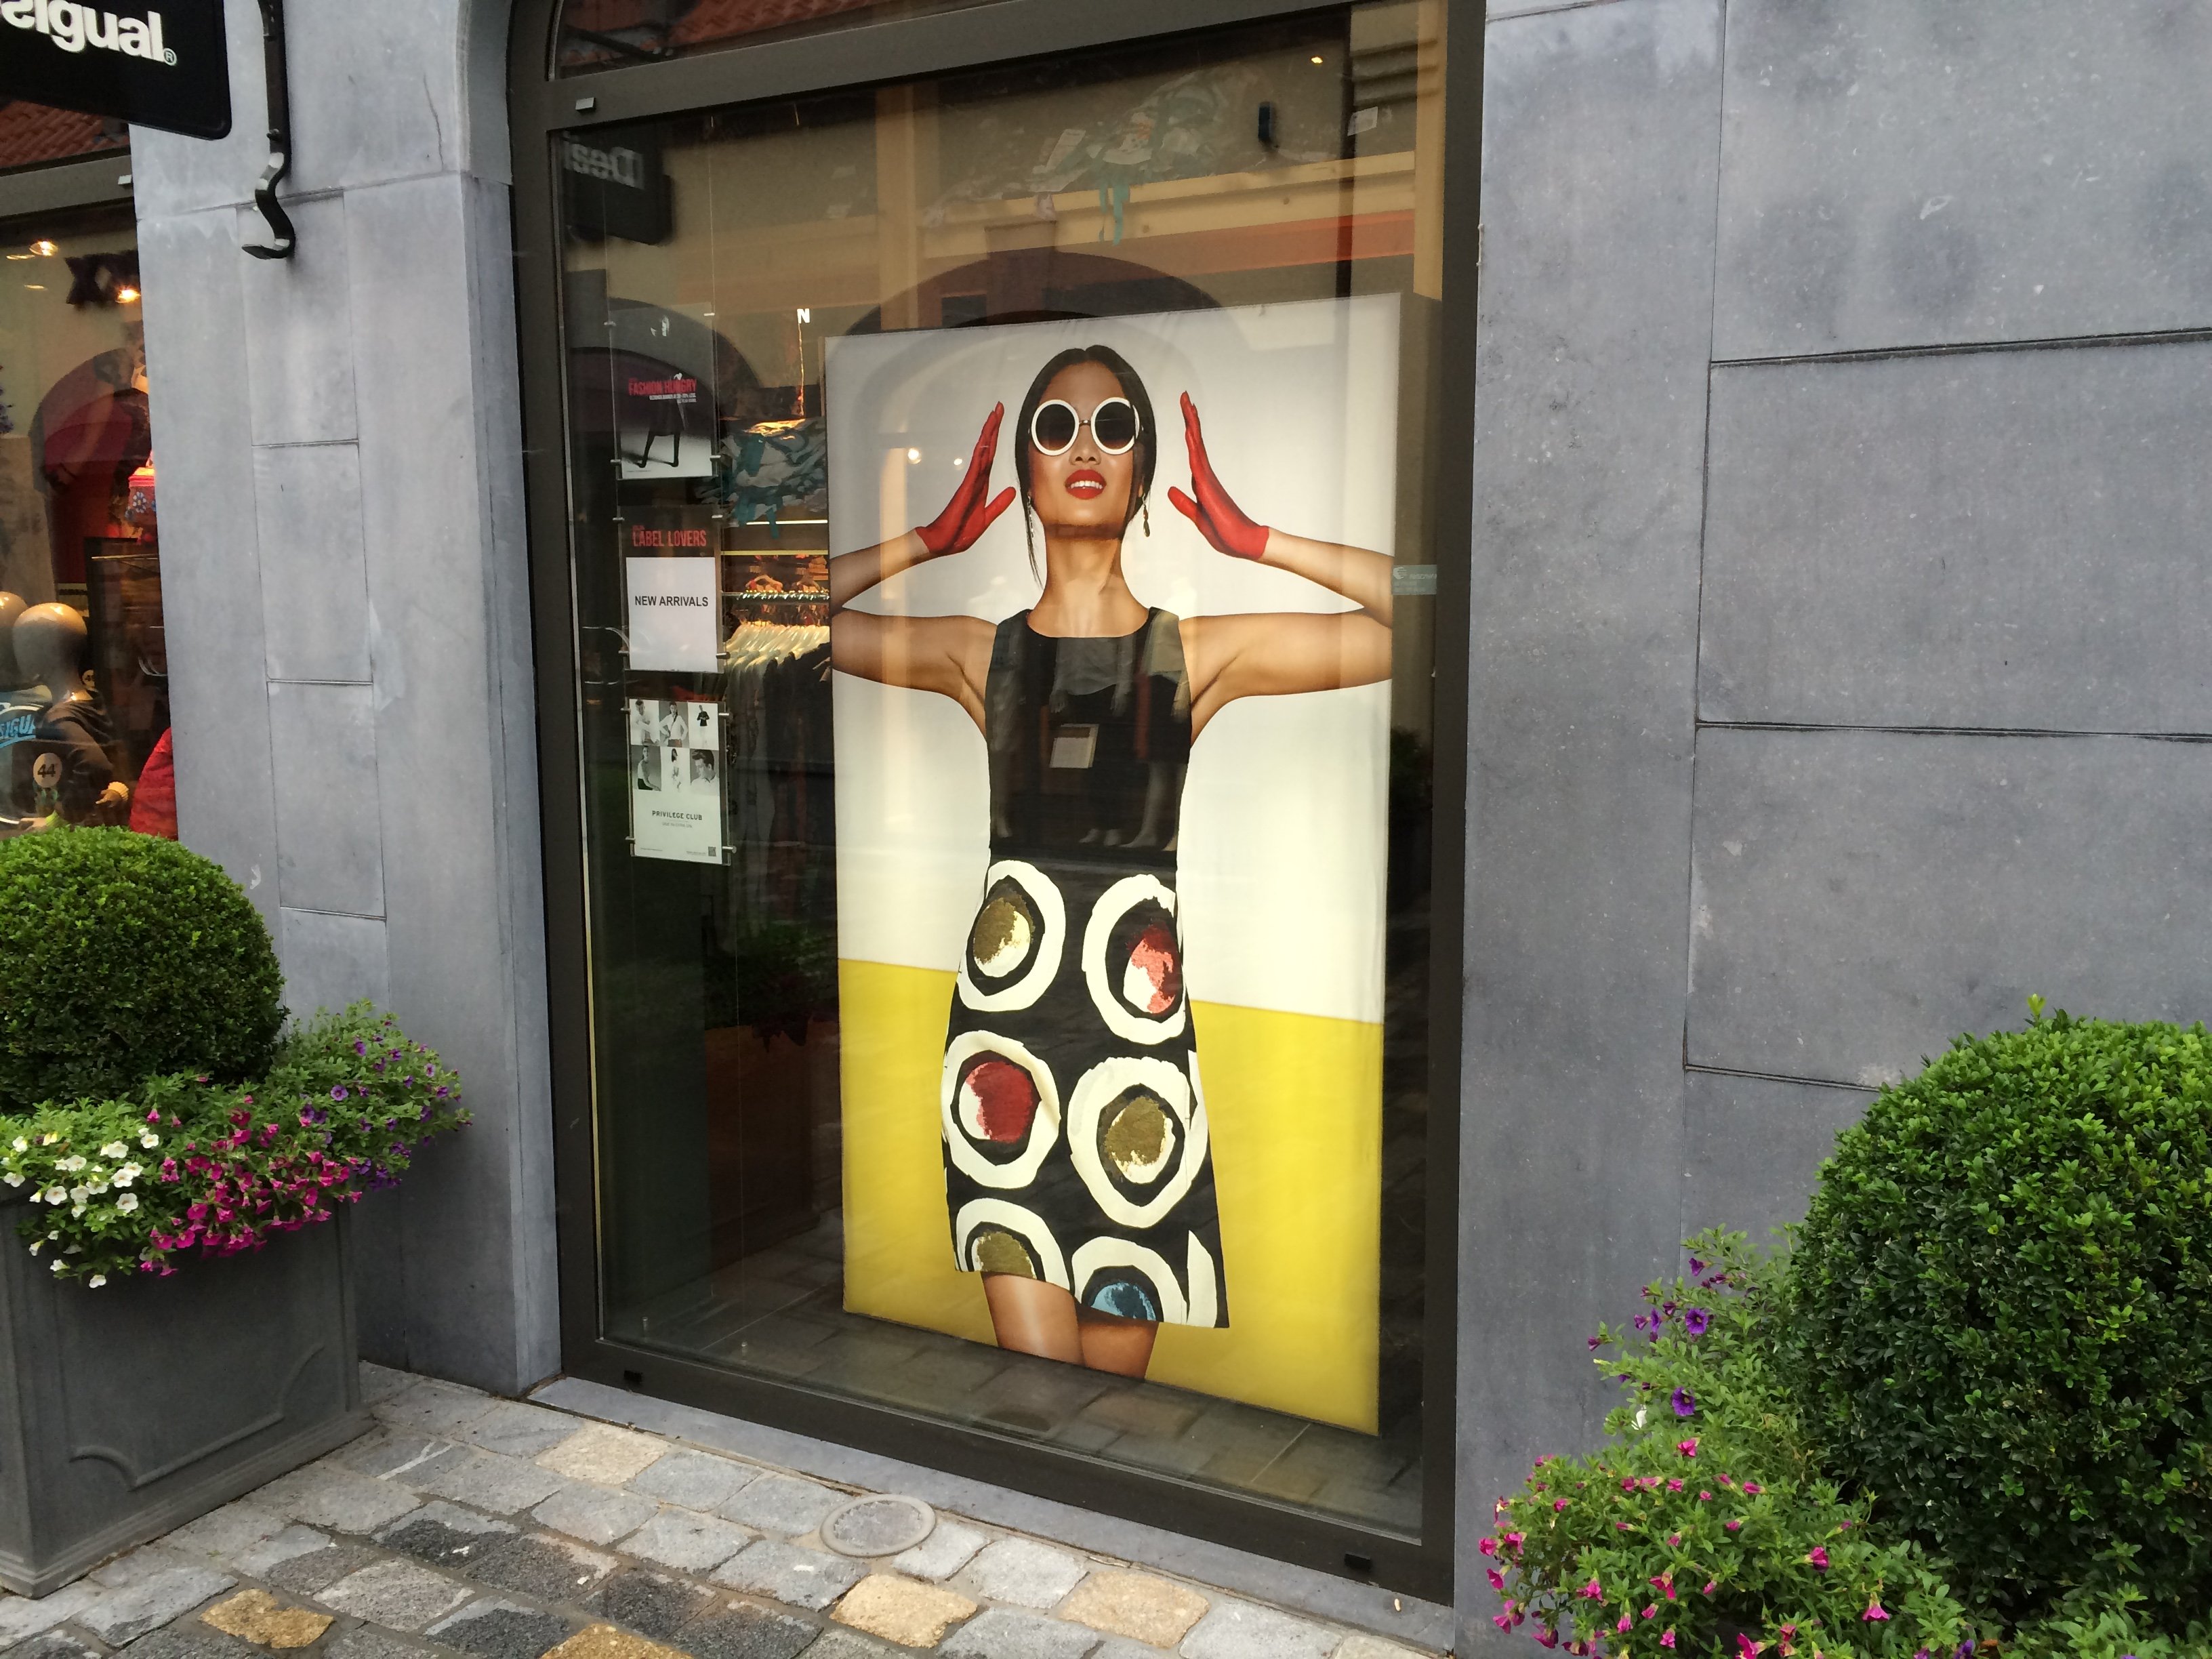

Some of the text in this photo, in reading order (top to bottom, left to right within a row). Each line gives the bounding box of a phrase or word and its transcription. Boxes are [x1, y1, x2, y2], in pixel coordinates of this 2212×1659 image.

[0, 0, 165, 63] sigual
[629, 379, 697, 396] FASHION HUNGRY
[632, 530, 707, 547] LABEL LOVERS
[635, 596, 709, 607] NEW ARRIVALS
[37, 764, 56, 778] 44
[652, 810, 684, 819] PRIVILEGE
